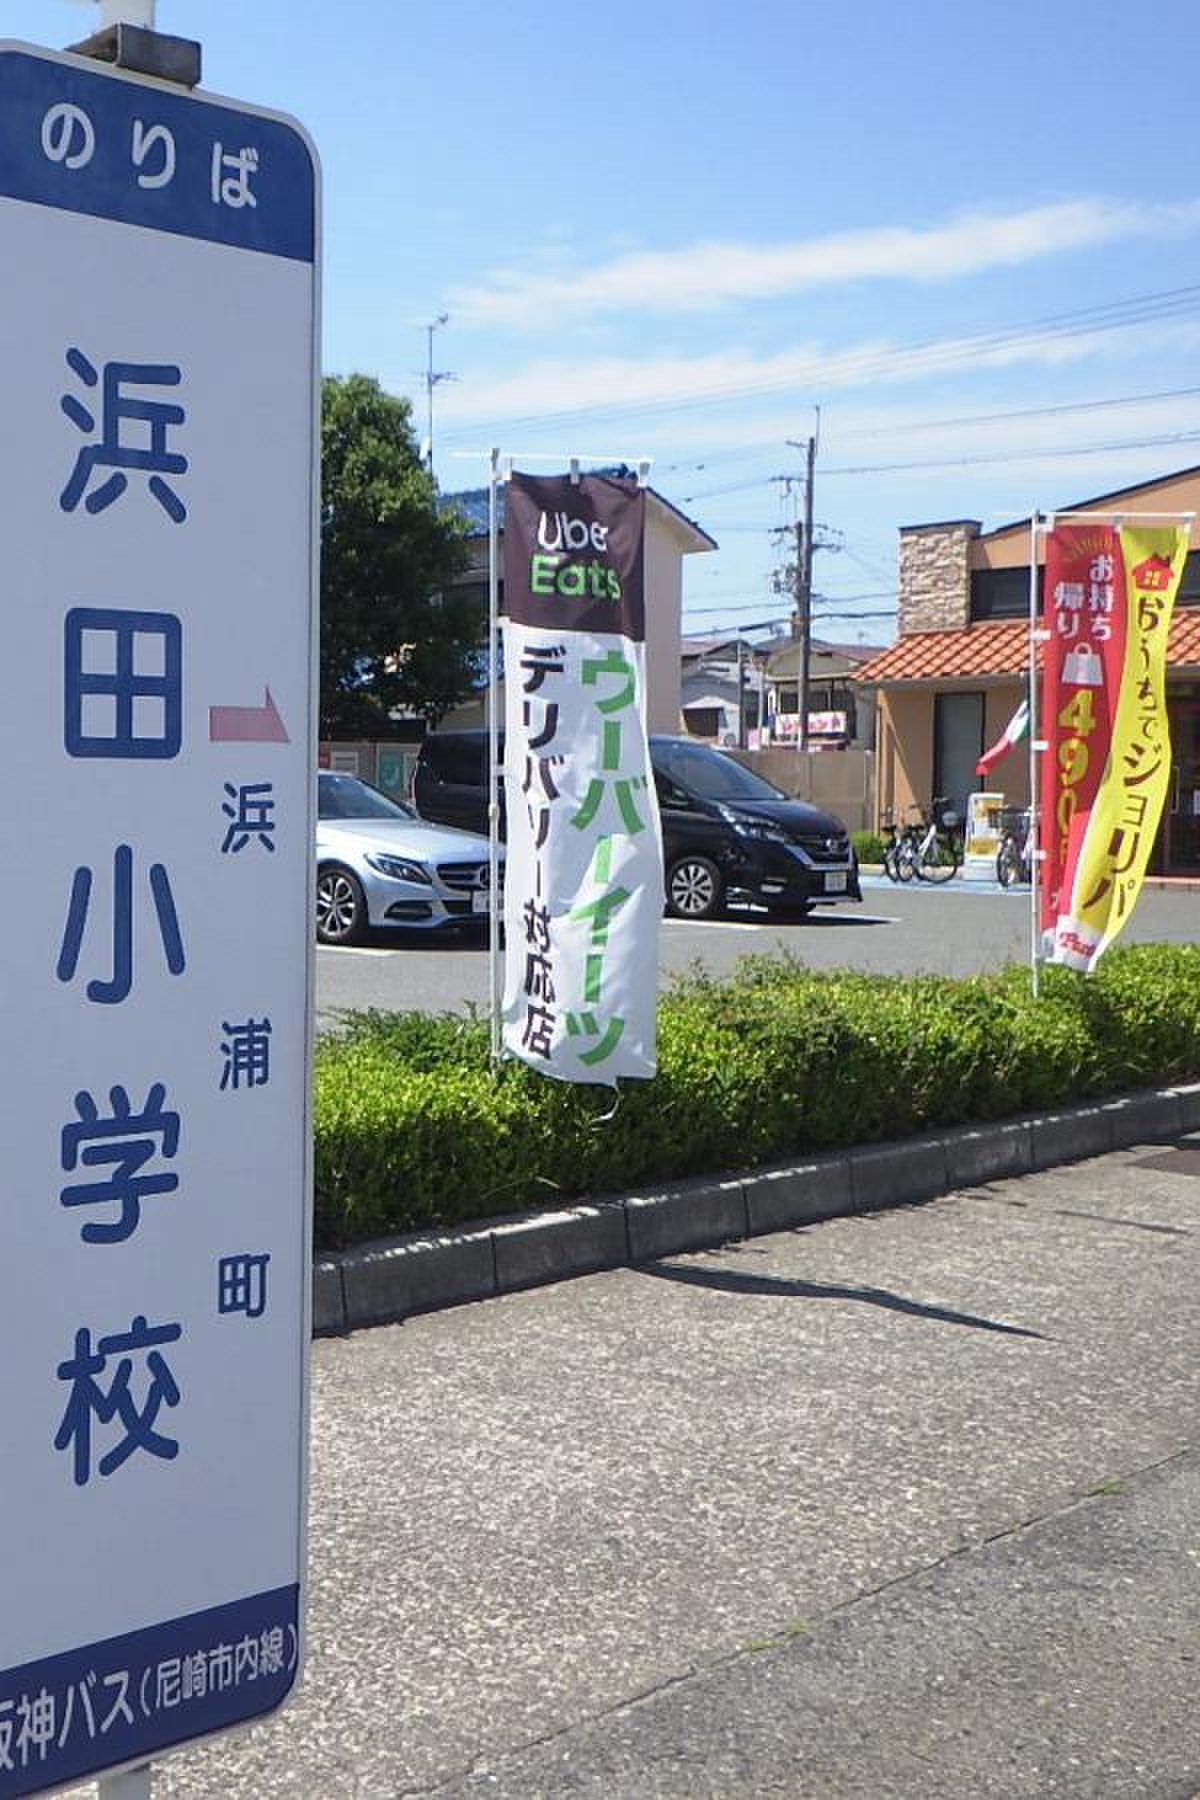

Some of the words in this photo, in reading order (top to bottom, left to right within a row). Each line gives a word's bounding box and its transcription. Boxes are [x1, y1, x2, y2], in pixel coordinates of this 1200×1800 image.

[41, 102, 259, 209] のりば
[530, 553, 622, 601] Eats
[537, 511, 609, 551] Ube
[54, 346, 188, 1487] 浜田小学校
[219, 781, 275, 1319] 浜浦町
[519, 645, 567, 1060] デリバリー対応店
[563, 650, 648, 1067] ウーバーイーツ
